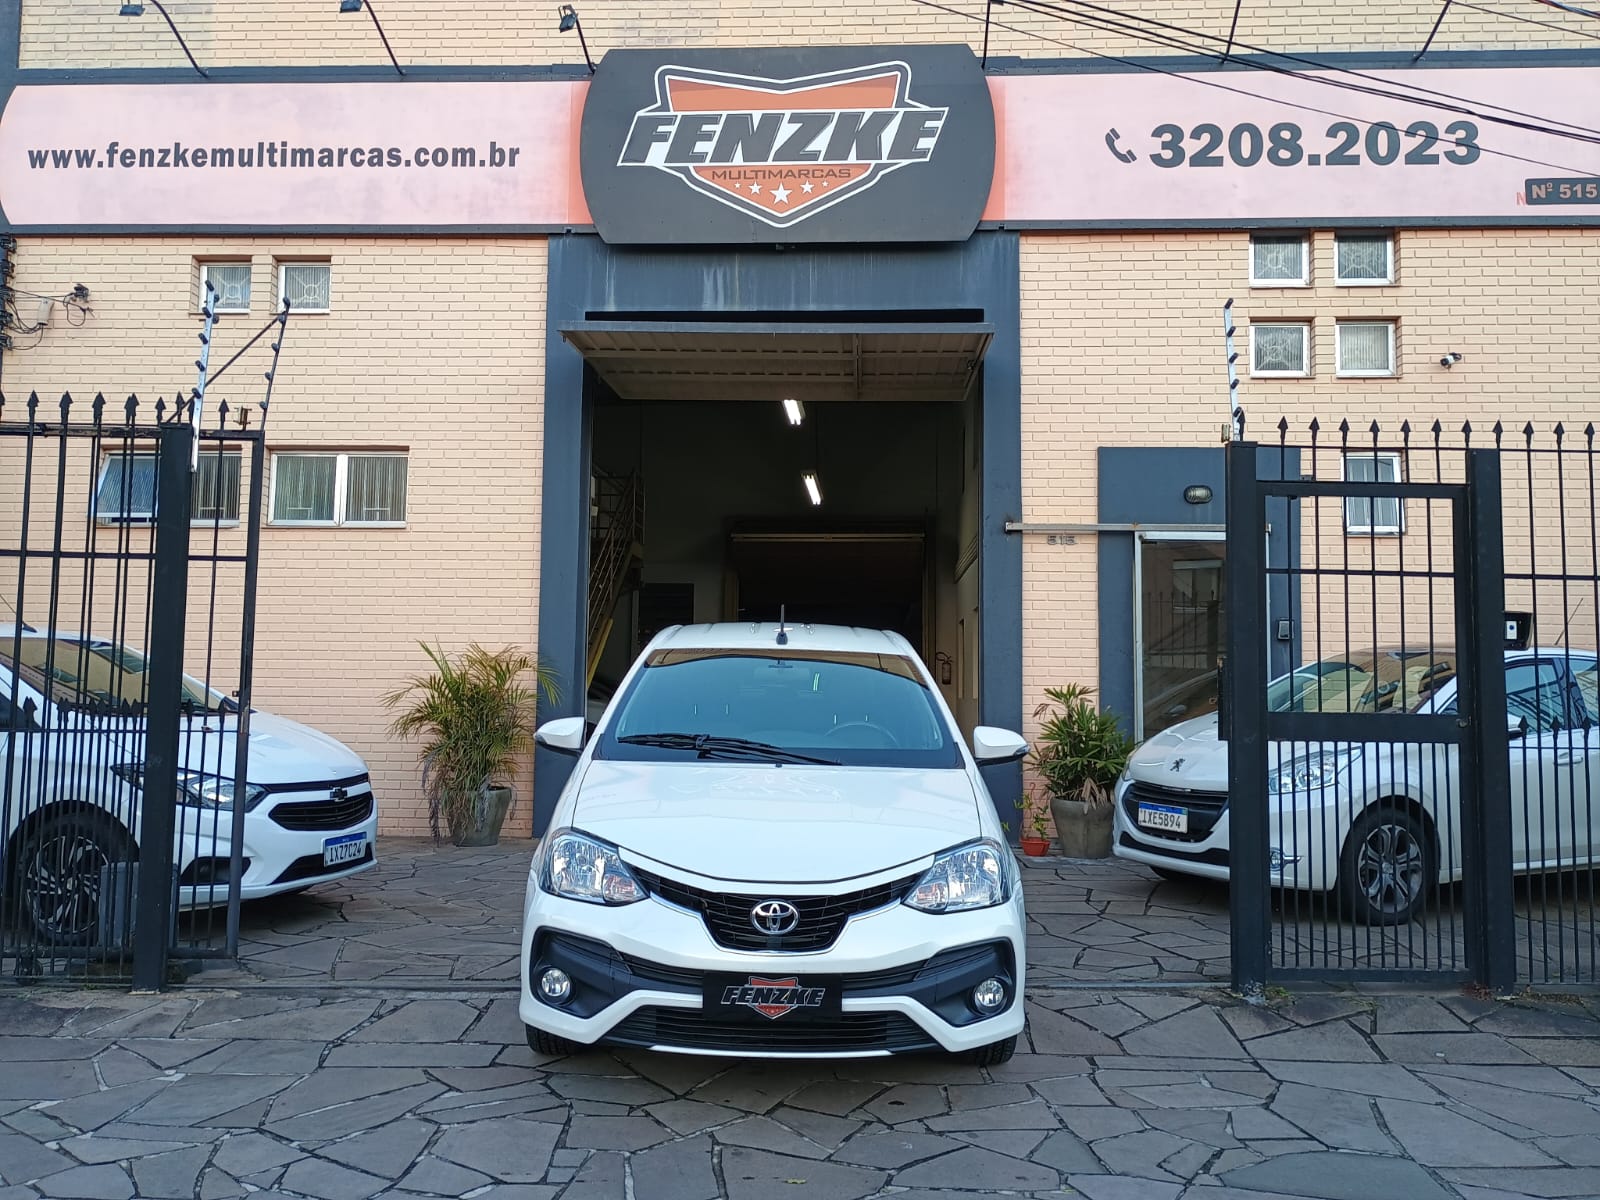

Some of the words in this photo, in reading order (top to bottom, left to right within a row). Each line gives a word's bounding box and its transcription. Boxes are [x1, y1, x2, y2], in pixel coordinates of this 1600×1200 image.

[617, 107, 949, 166] FENZKE
[1149, 120, 1481, 168] 3208.2023
[28, 141, 520, 169] www.fenzkemultimarcas.com.br
[711, 167, 851, 181] MULTIMARCAS
[1559, 183, 1598, 199] 515
[1047, 535, 1075, 545] 515
[721, 986, 825, 1006] FENZKE
